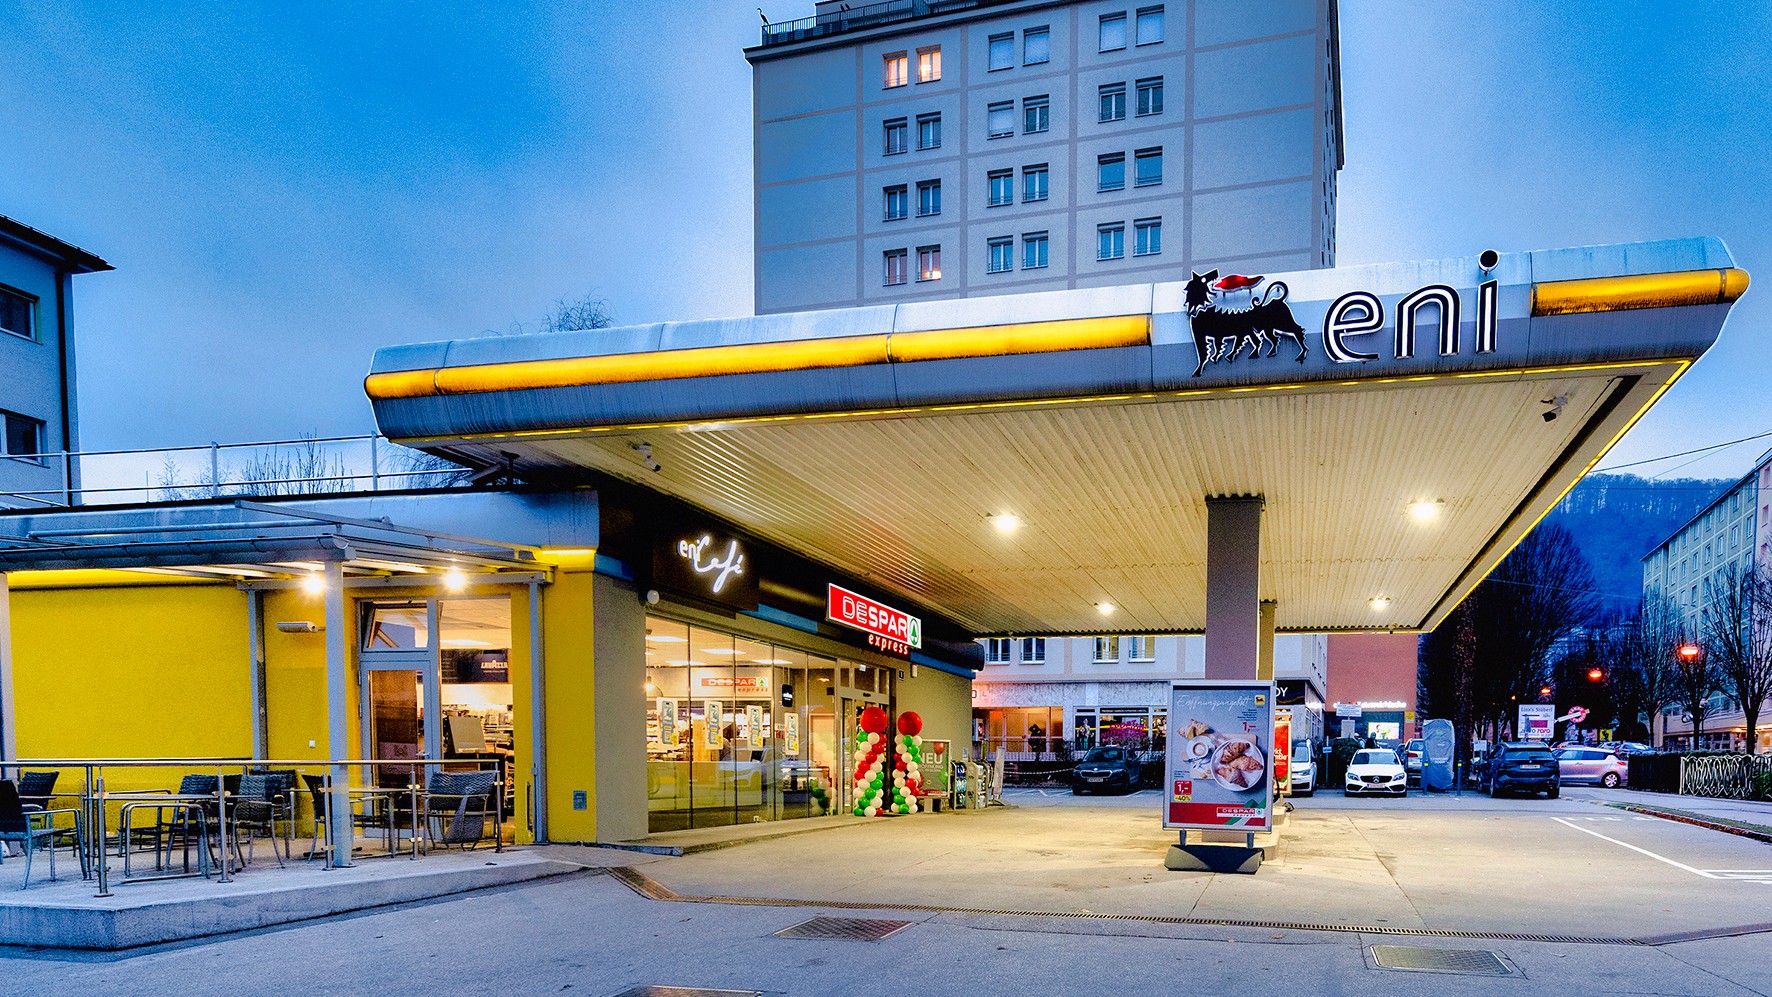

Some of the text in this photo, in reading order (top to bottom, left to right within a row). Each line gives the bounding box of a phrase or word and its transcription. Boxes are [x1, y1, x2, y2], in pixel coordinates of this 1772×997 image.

[1322, 250, 1500, 364] eni
[679, 536, 744, 593] eni Café
[842, 595, 908, 639] DESPAR
[868, 634, 909, 655] express
